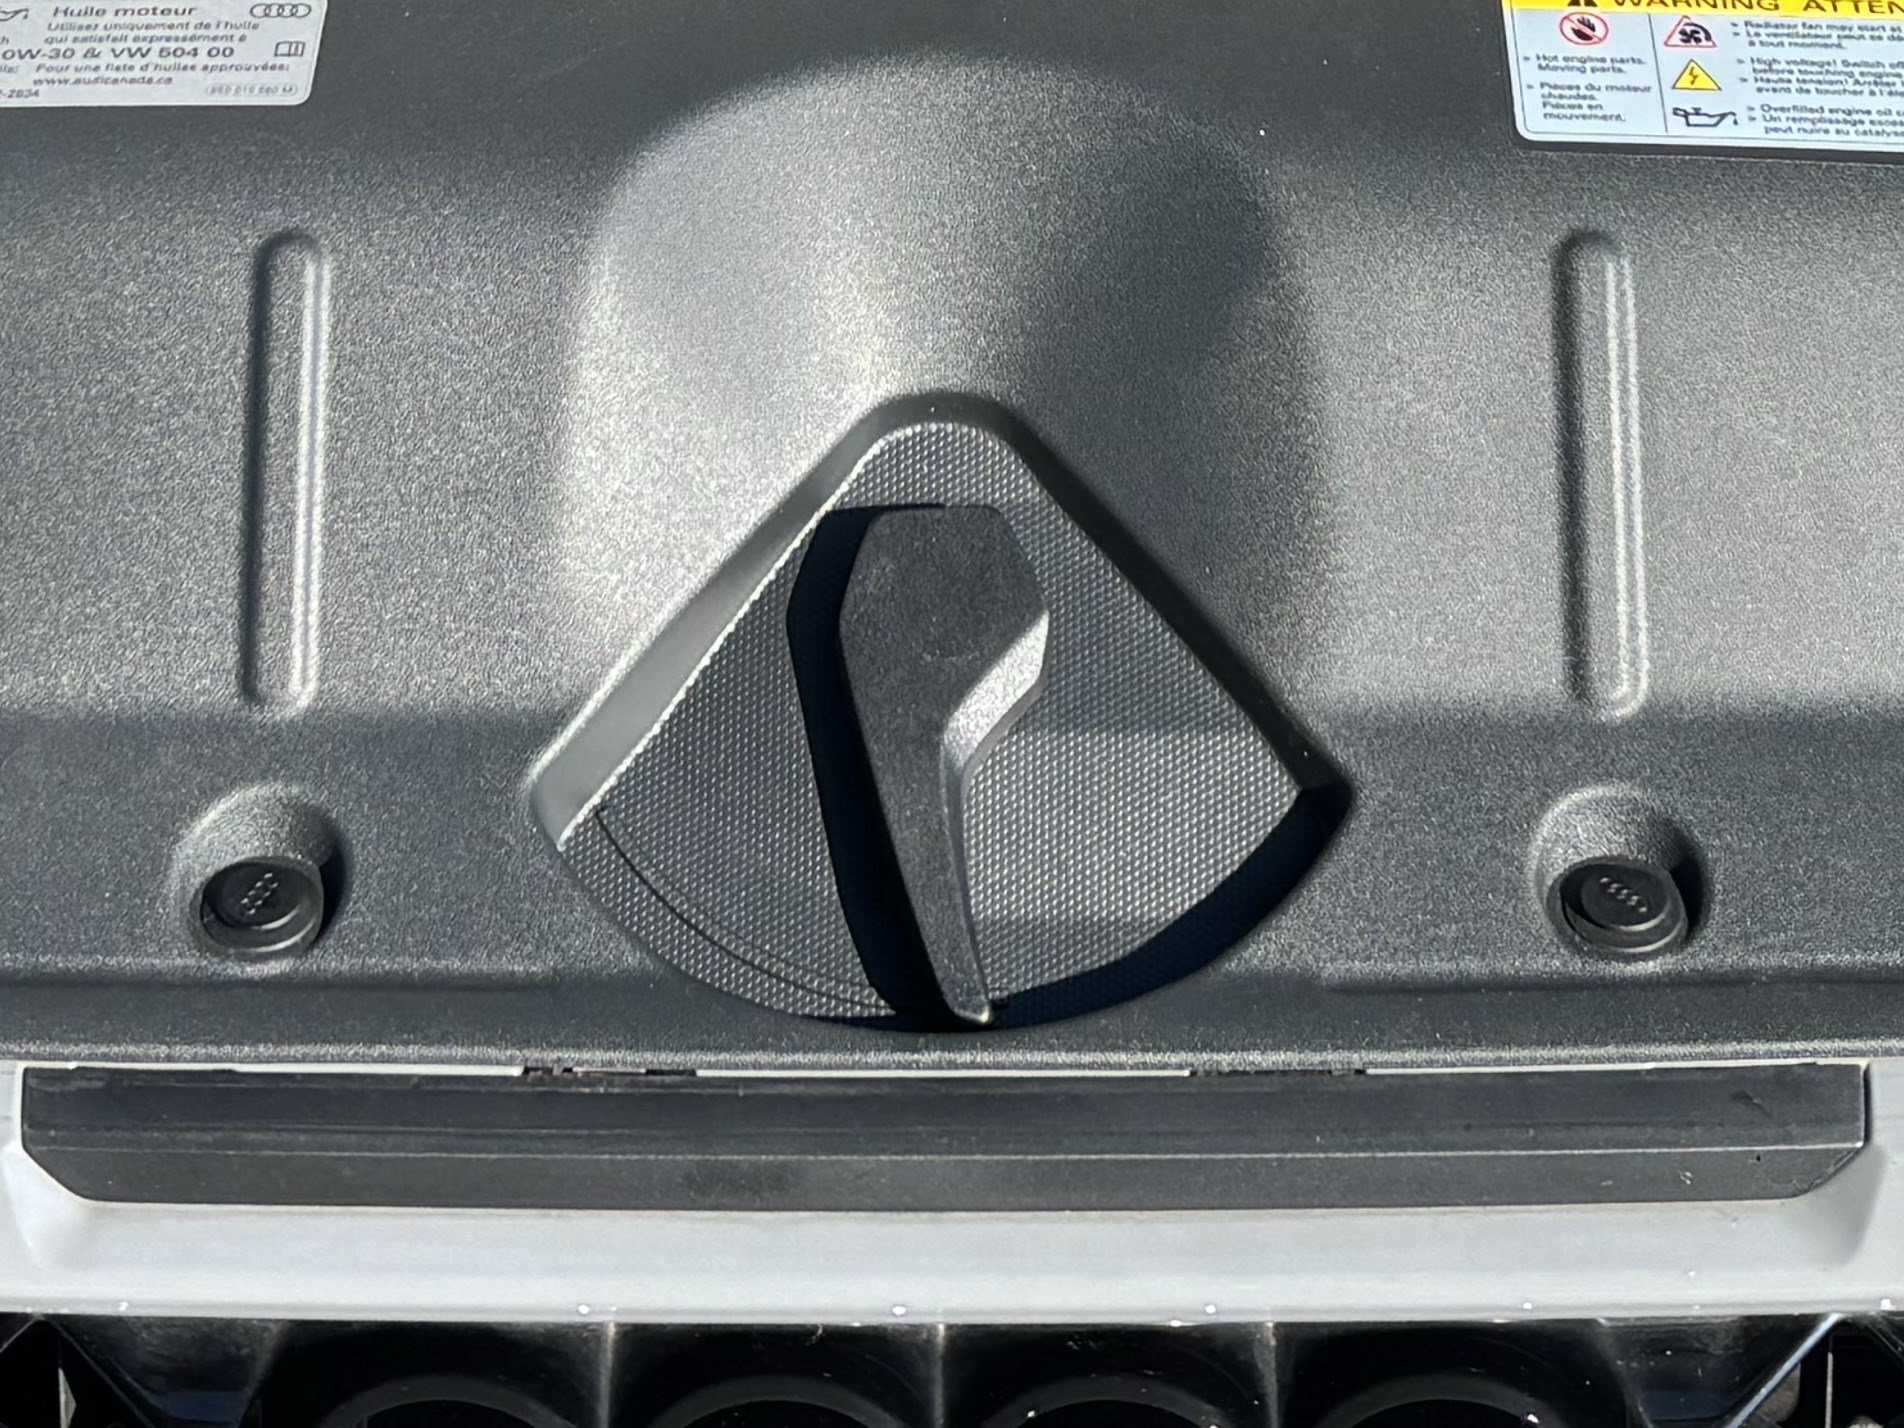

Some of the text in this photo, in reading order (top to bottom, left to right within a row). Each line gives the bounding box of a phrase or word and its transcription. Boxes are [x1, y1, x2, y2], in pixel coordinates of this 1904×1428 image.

[52, 6, 198, 18] Huile moteur
[2, 48, 76, 61] 0W-30
[83, 47, 101, 59] &
[110, 47, 152, 59] VW
[158, 46, 199, 59] 504
[207, 46, 234, 58] 00
